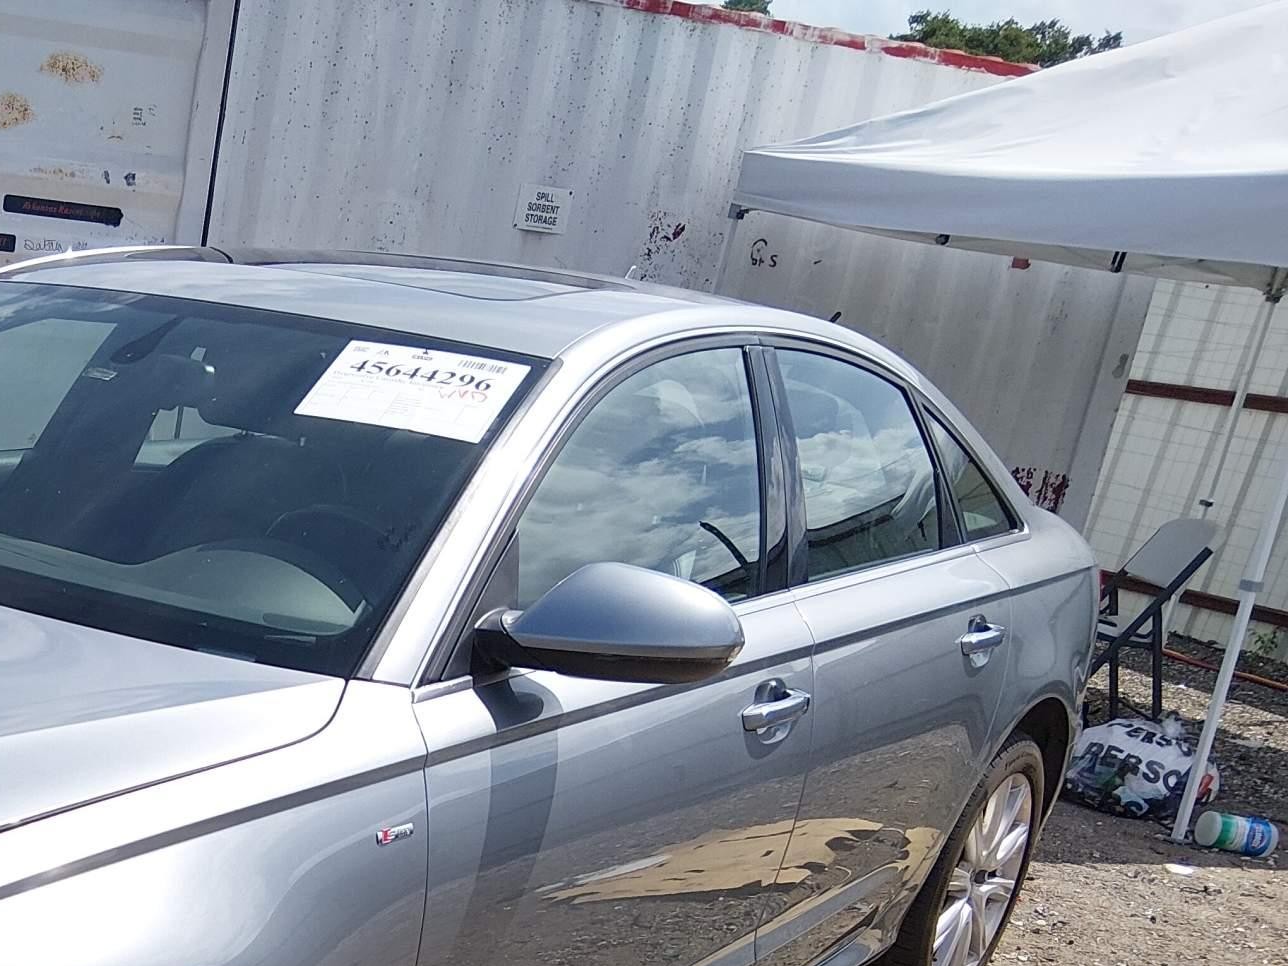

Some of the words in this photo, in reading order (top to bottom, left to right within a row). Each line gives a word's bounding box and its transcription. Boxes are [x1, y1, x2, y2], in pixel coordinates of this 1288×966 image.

[536, 191, 554, 203] SPILL
[527, 201, 561, 215] SORBENT
[524, 212, 558, 226] STORAGE
[349, 358, 496, 392] 45644296
